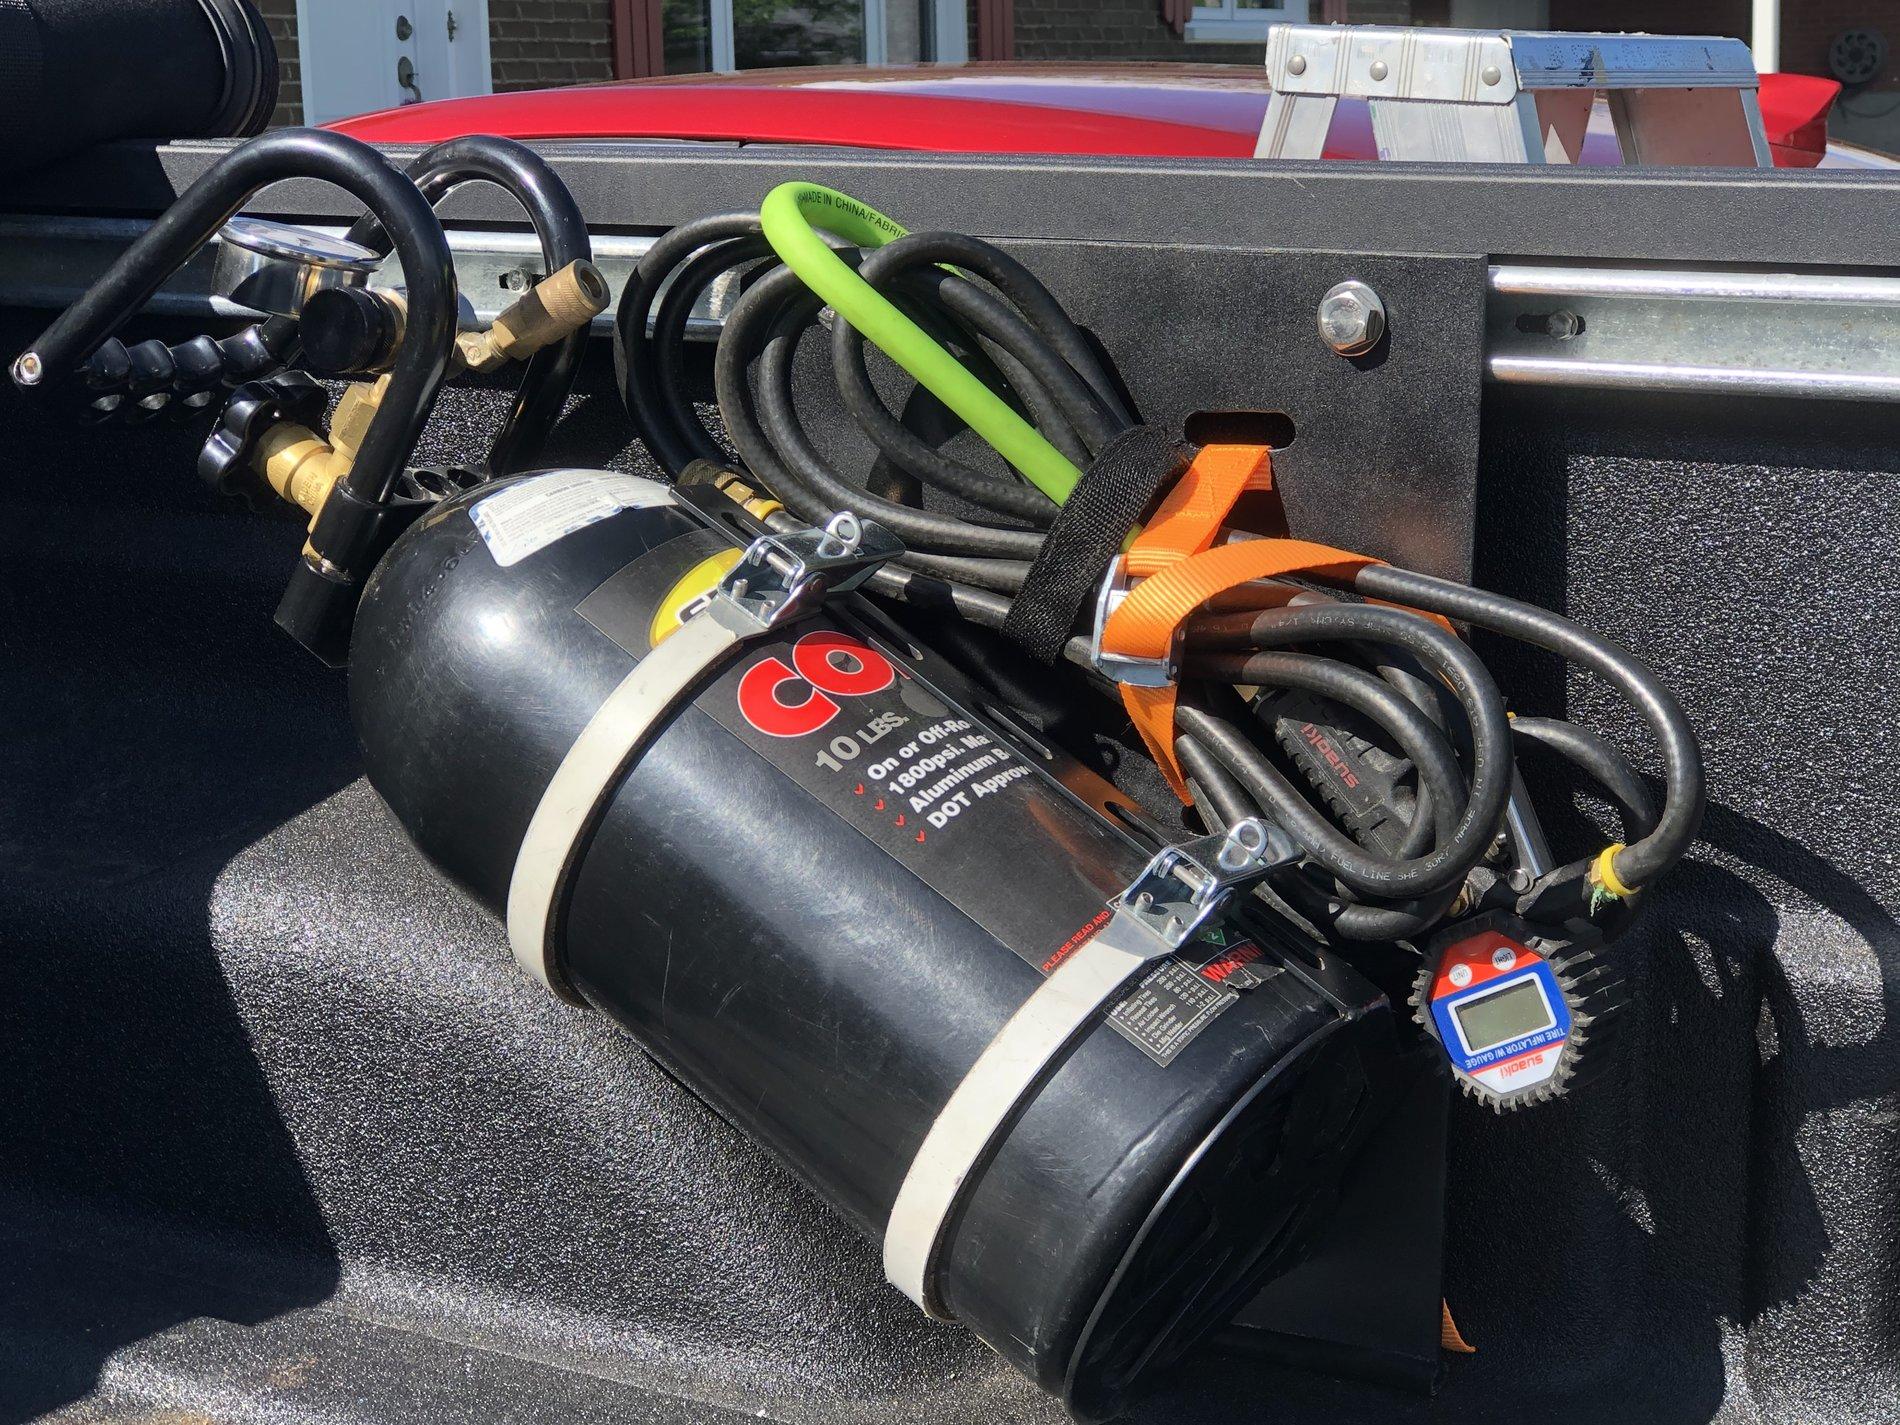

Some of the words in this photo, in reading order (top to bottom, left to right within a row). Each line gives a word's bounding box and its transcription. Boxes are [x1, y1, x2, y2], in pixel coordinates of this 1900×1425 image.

[803, 191, 822, 204] MADE
[823, 192, 832, 205] IN
[737, 630, 911, 737] CO
[814, 736, 861, 772] 10
[856, 711, 910, 745] LBS.
[867, 756, 900, 780] On
[899, 739, 921, 759] or
[917, 719, 972, 746] Off-Ro
[1301, 723, 1360, 789] suaoki
[889, 740, 966, 795] 1800psi.
[963, 734, 993, 750] Ma
[908, 754, 998, 813] Aluminum
[990, 749, 1012, 760] B
[926, 791, 972, 829] DOT
[970, 764, 1032, 799] Approv
[1330, 854, 1356, 873] FUEL
[1362, 867, 1391, 881] LINE
[1042, 942, 1074, 972] PLEASE
[1071, 923, 1095, 944] READ
[1201, 943, 1265, 983] WARNI
[1138, 958, 1171, 990] PRESSURE
[1507, 1034, 1547, 1056] INFLATOR
[1544, 1027, 1566, 1041] TIRE
[1464, 1052, 1495, 1069] GAUGE
[1500, 1055, 1544, 1079] suaoki
